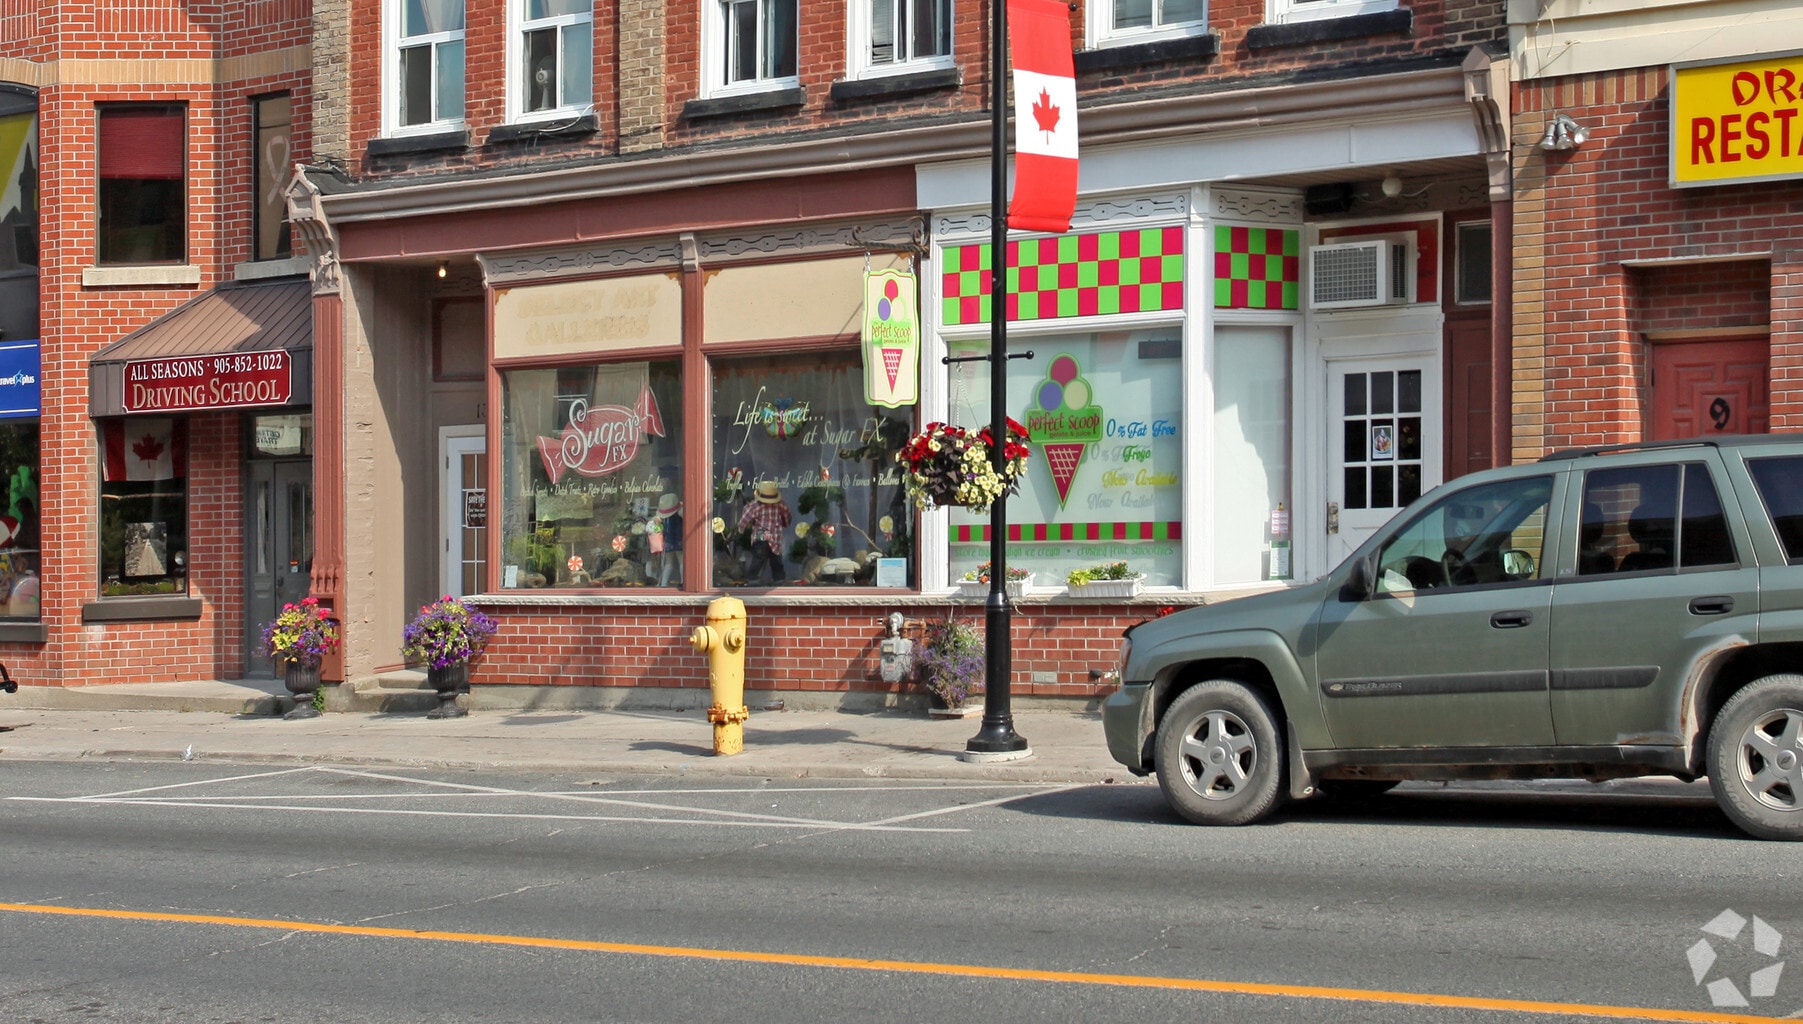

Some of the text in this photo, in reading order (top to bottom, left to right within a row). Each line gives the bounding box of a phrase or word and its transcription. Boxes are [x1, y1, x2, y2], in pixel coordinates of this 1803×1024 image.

[1732, 68, 1803, 107] DR
[1691, 108, 1803, 165] REST
[872, 322, 911, 344] perfect scoop
[21, 375, 35, 386] plus
[130, 353, 283, 381] ALL SEASONS 905-852-1022
[132, 377, 281, 409] DRIVING SCHOOL
[732, 386, 766, 454] Life
[1028, 411, 1100, 435] perfect scoop
[1709, 396, 1731, 429] 9
[561, 397, 640, 469] Sugar
[803, 417, 887, 449] at Sugar FX
[1127, 421, 1147, 439] Fat
[1152, 419, 1176, 438] Free
[611, 443, 628, 462] FX
[1037, 546, 1061, 557] cream
